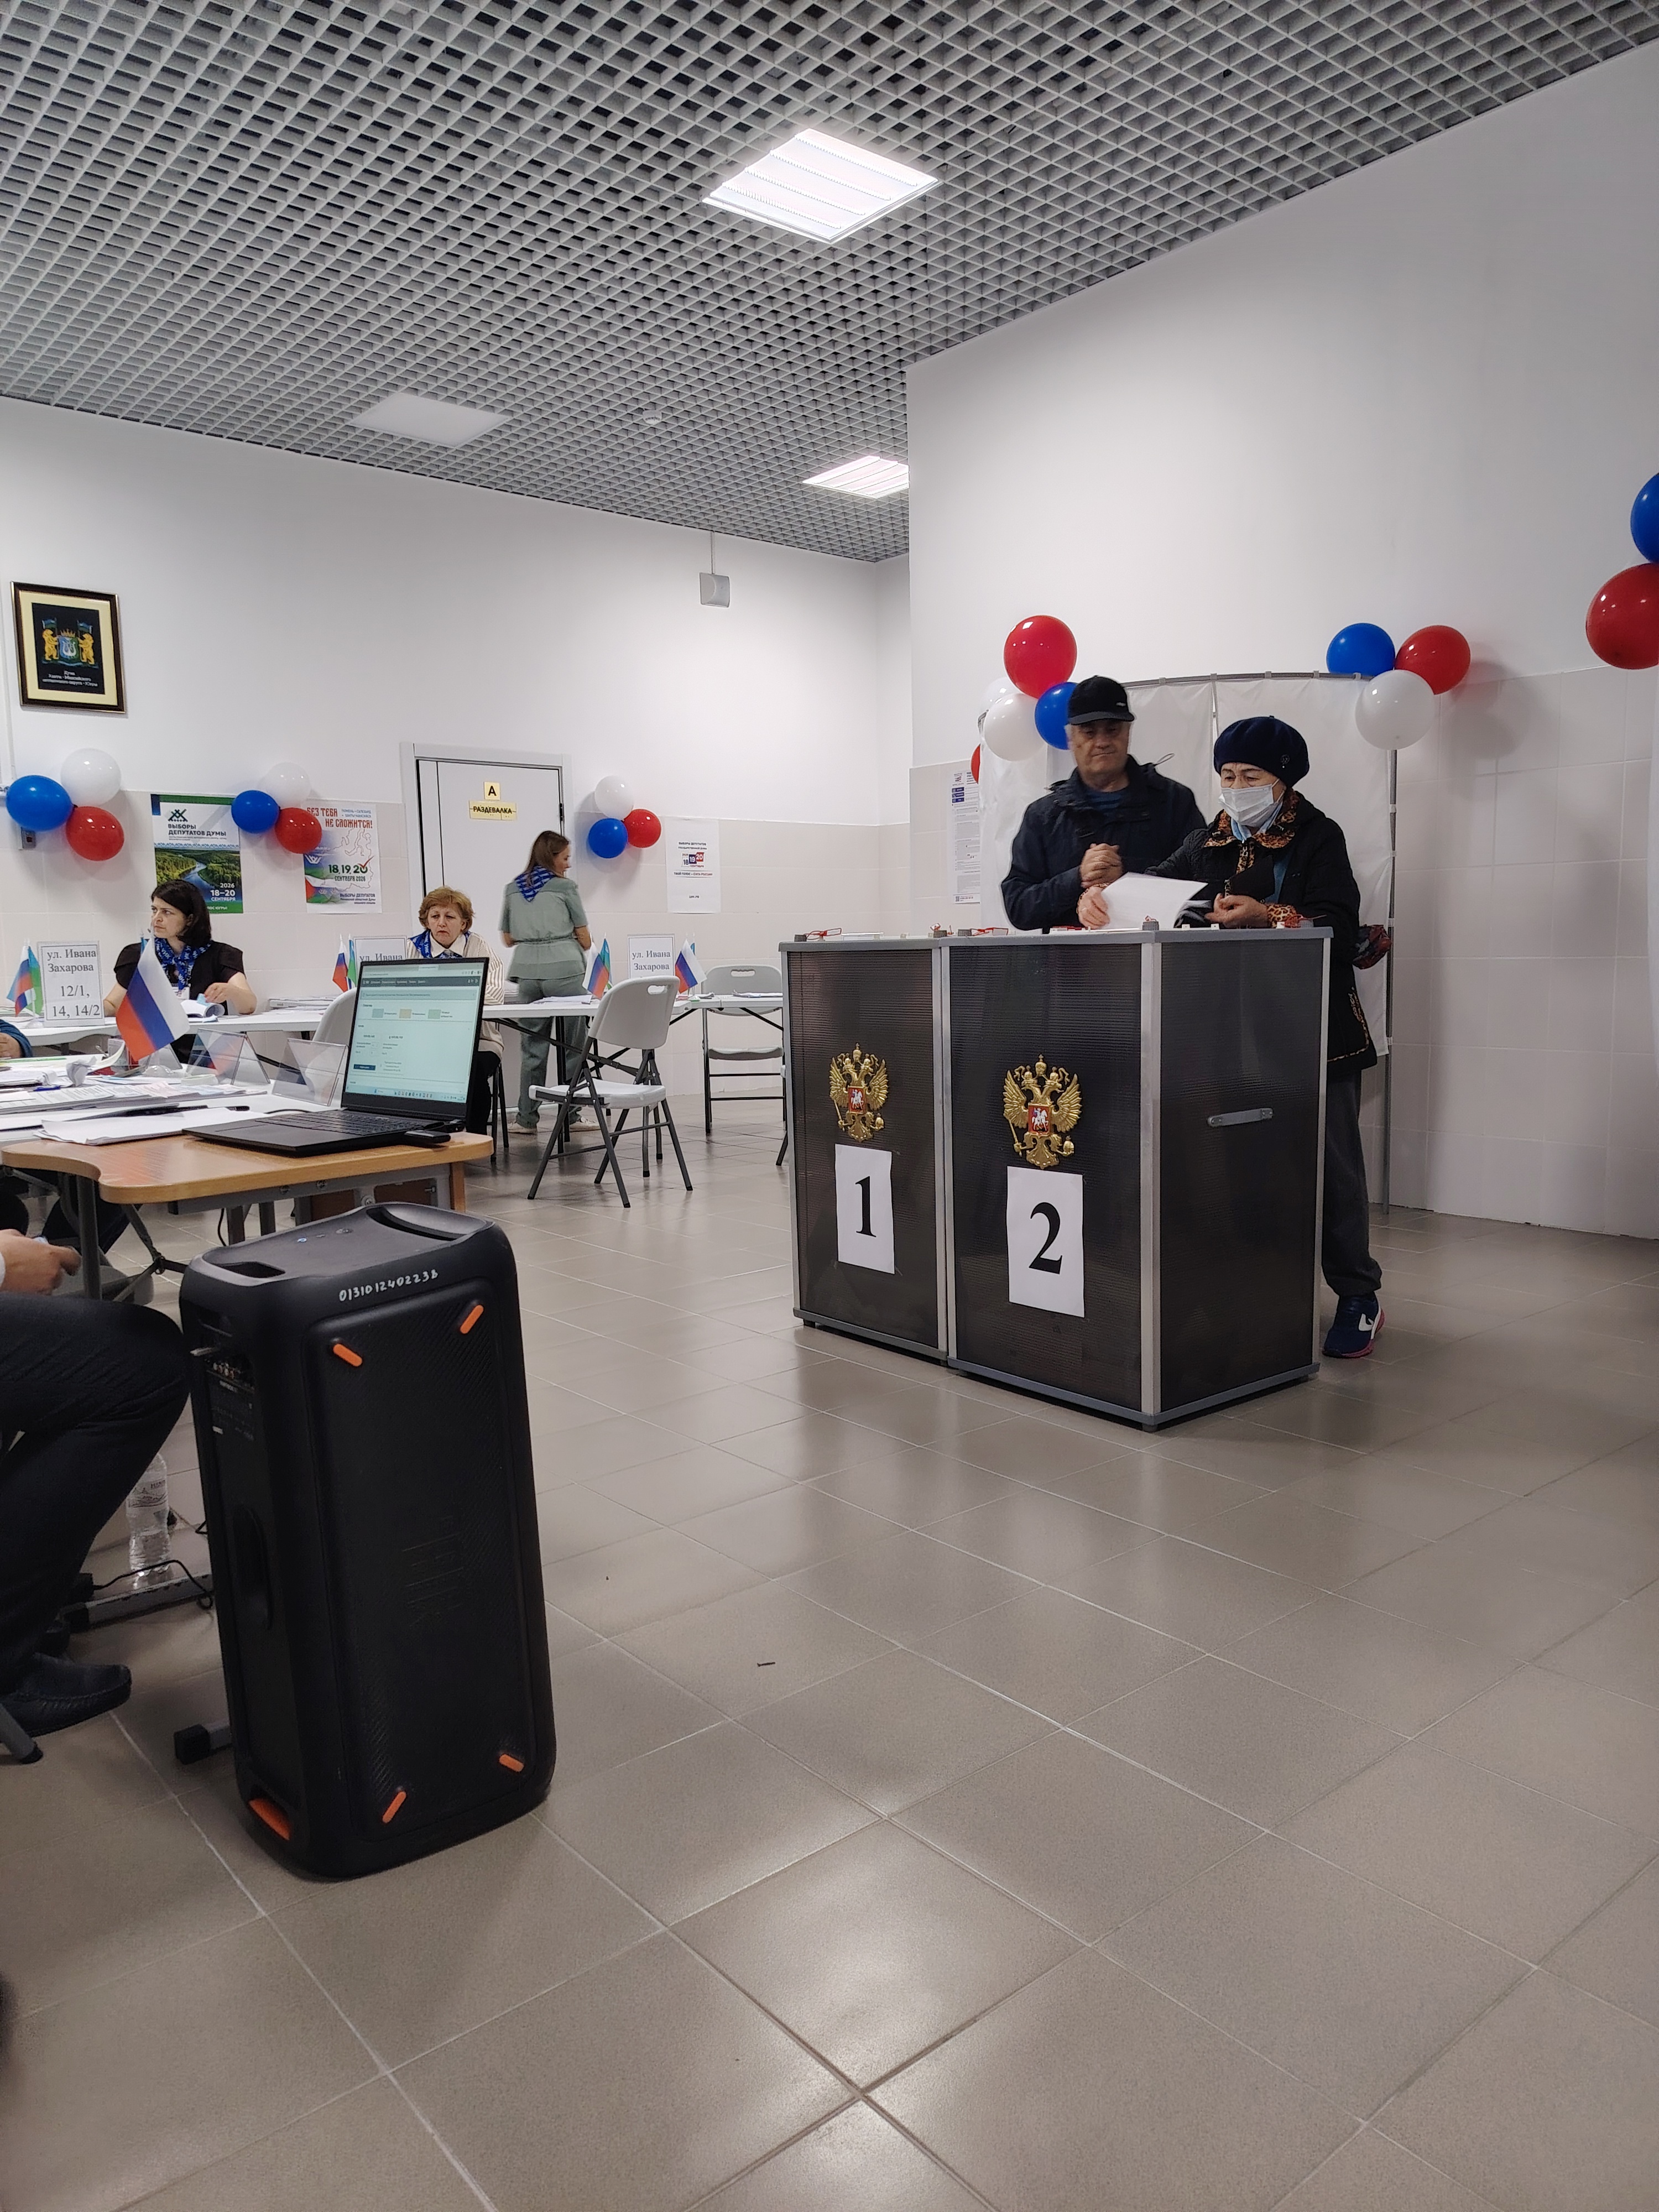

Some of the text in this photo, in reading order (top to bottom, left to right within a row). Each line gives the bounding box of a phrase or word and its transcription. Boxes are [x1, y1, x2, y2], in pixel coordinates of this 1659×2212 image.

[321, 808, 338, 817] ТЕБЯ
[473, 806, 513, 815] РАЗДЕВАЛКА
[325, 818, 373, 829] НЕ СЛОЖИТСЯ!
[47, 949, 96, 961] ул. Ивана
[375, 953, 403, 961] Ивана
[48, 963, 94, 974] Захарова
[634, 963, 670, 972] Захарова
[61, 985, 90, 998] 12/1,
[53, 1004, 101, 1019] 14, 14/2
[855, 1176, 877, 1238] 1
[1029, 1202, 1063, 1275] 2
